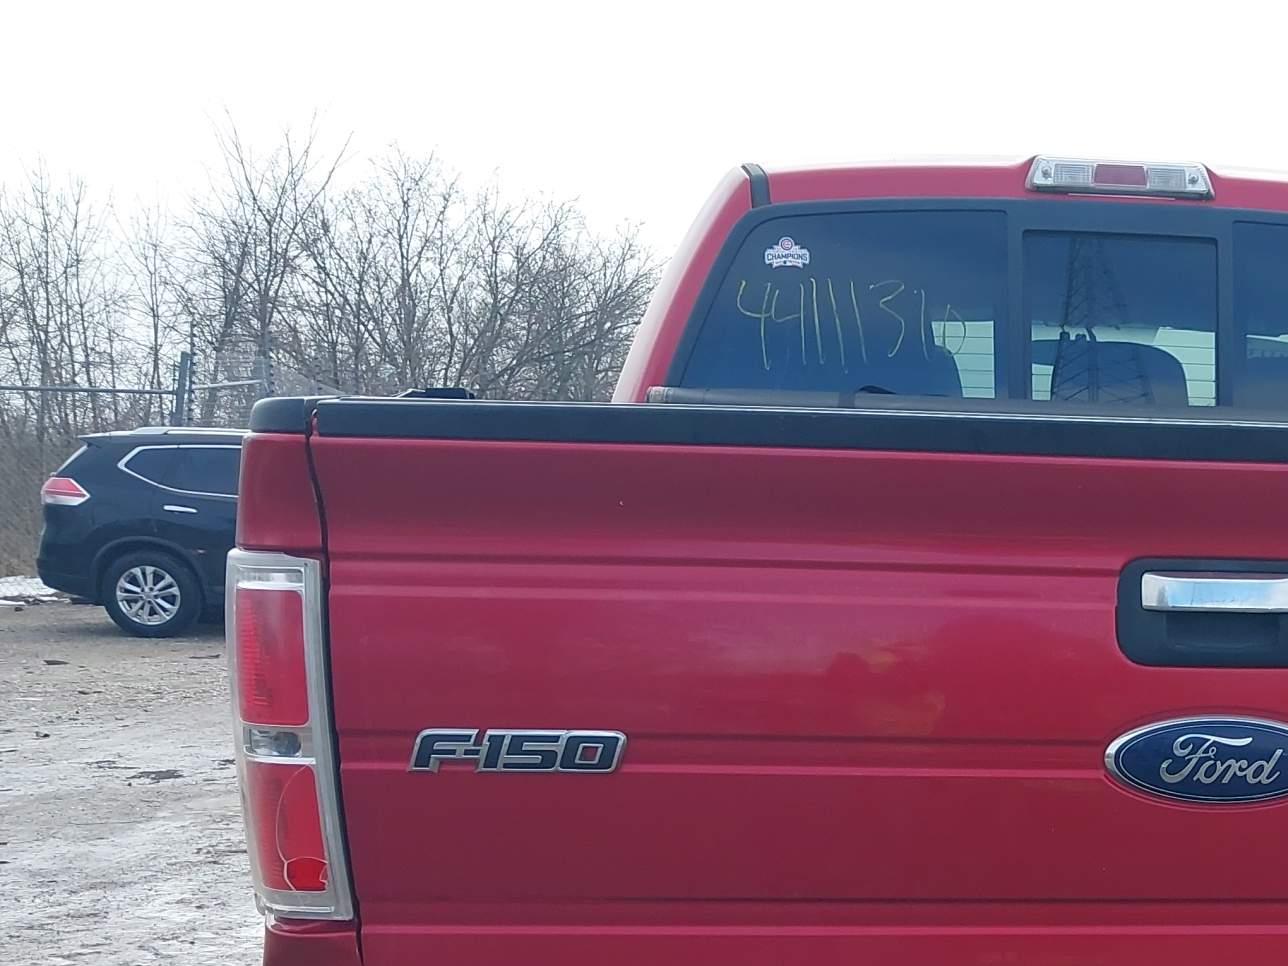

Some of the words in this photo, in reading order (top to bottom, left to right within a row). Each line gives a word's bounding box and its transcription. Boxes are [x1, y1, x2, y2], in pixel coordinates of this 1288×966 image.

[767, 252, 808, 261] CHAMPIONS
[736, 278, 967, 375] 44111310
[406, 728, 627, 773] F-150
[1159, 733, 1284, 784] Ford
